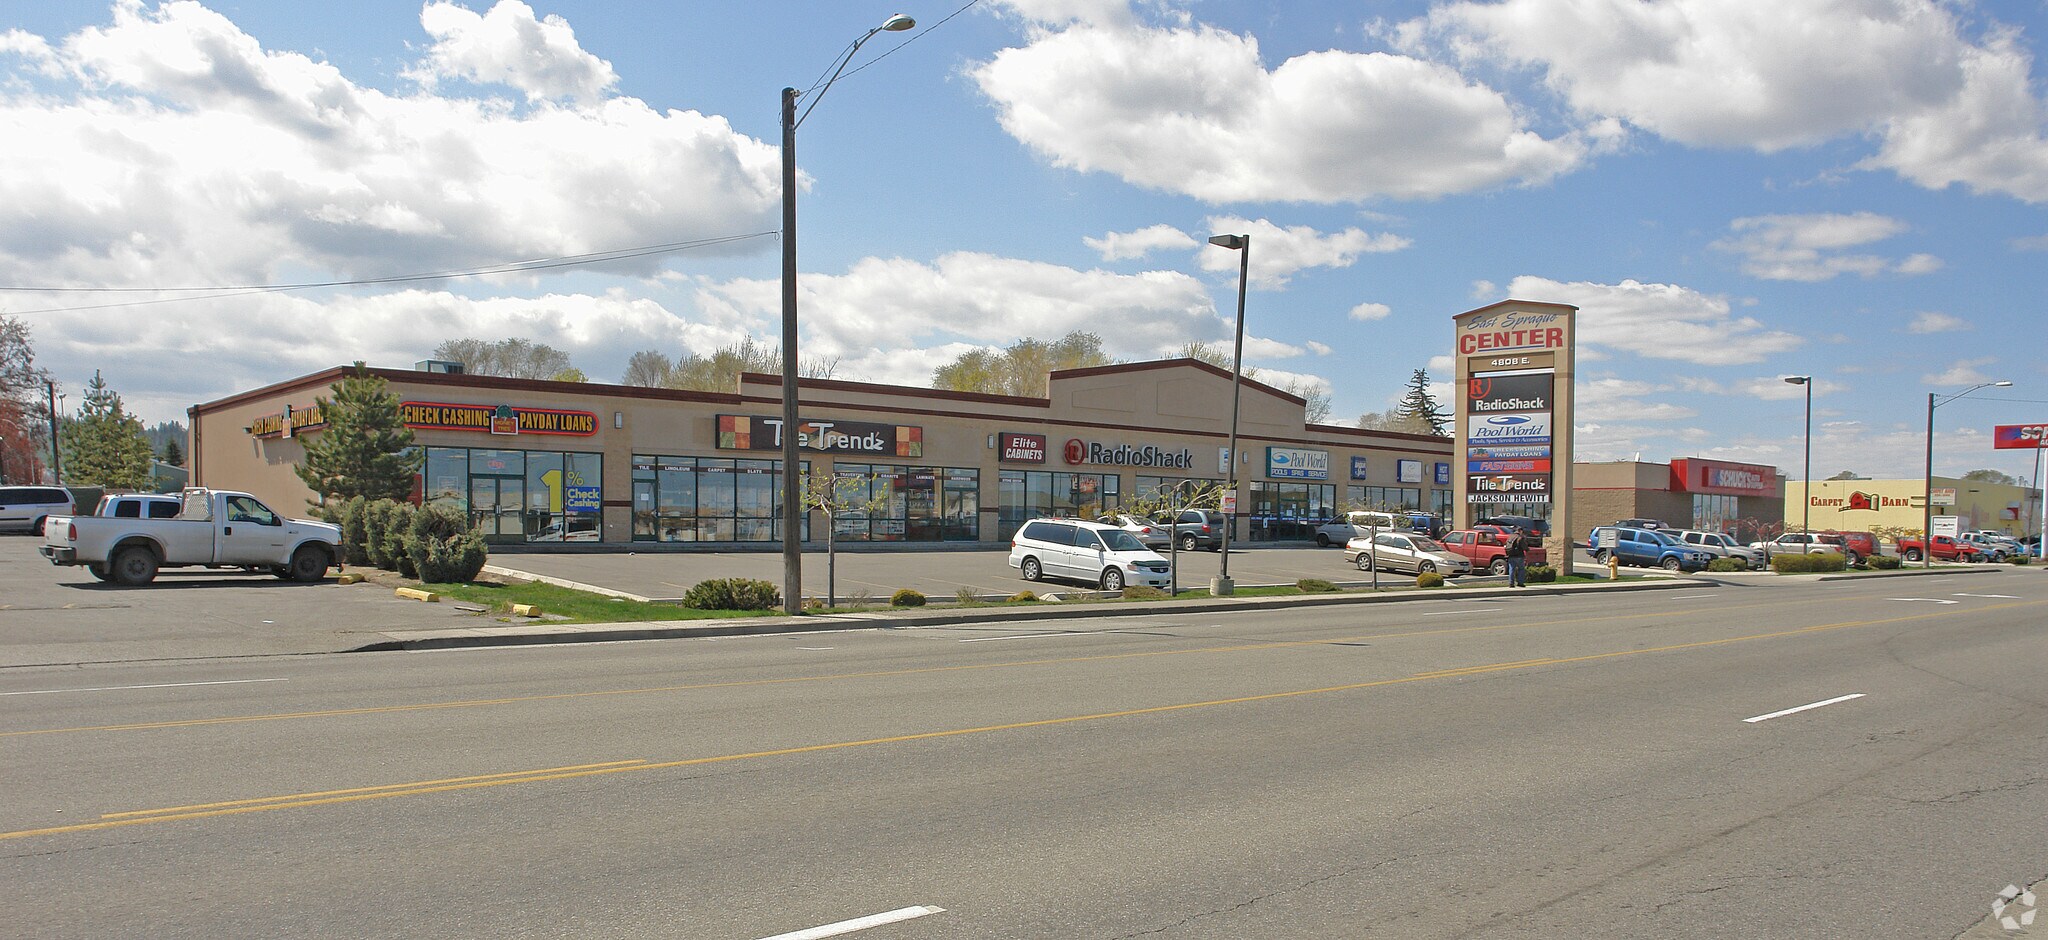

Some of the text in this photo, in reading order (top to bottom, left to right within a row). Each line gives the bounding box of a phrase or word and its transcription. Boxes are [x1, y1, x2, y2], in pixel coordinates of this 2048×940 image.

[1467, 312, 1558, 331] East Sprague
[1460, 327, 1563, 354] CENTER
[1491, 357, 1530, 366] 4808 E.
[1475, 397, 1545, 411] RadioShack
[404, 405, 593, 432] CHECK CASHING PAYDAY LOANS
[763, 419, 808, 447] Te
[1476, 425, 1544, 437] Pool World
[1012, 437, 1037, 449] Elite
[1005, 448, 1043, 461] CABINETS
[1088, 441, 1193, 469] RadioShack
[1290, 452, 1327, 469] Pool World
[1271, 468, 1288, 476] POOLS
[1470, 475, 1497, 490] Tile
[567, 488, 600, 499] Check
[1471, 494, 1546, 503] JACKSON HEWITT
[567, 499, 600, 509] Cashing
[1810, 496, 1909, 507] CARPET BARN
